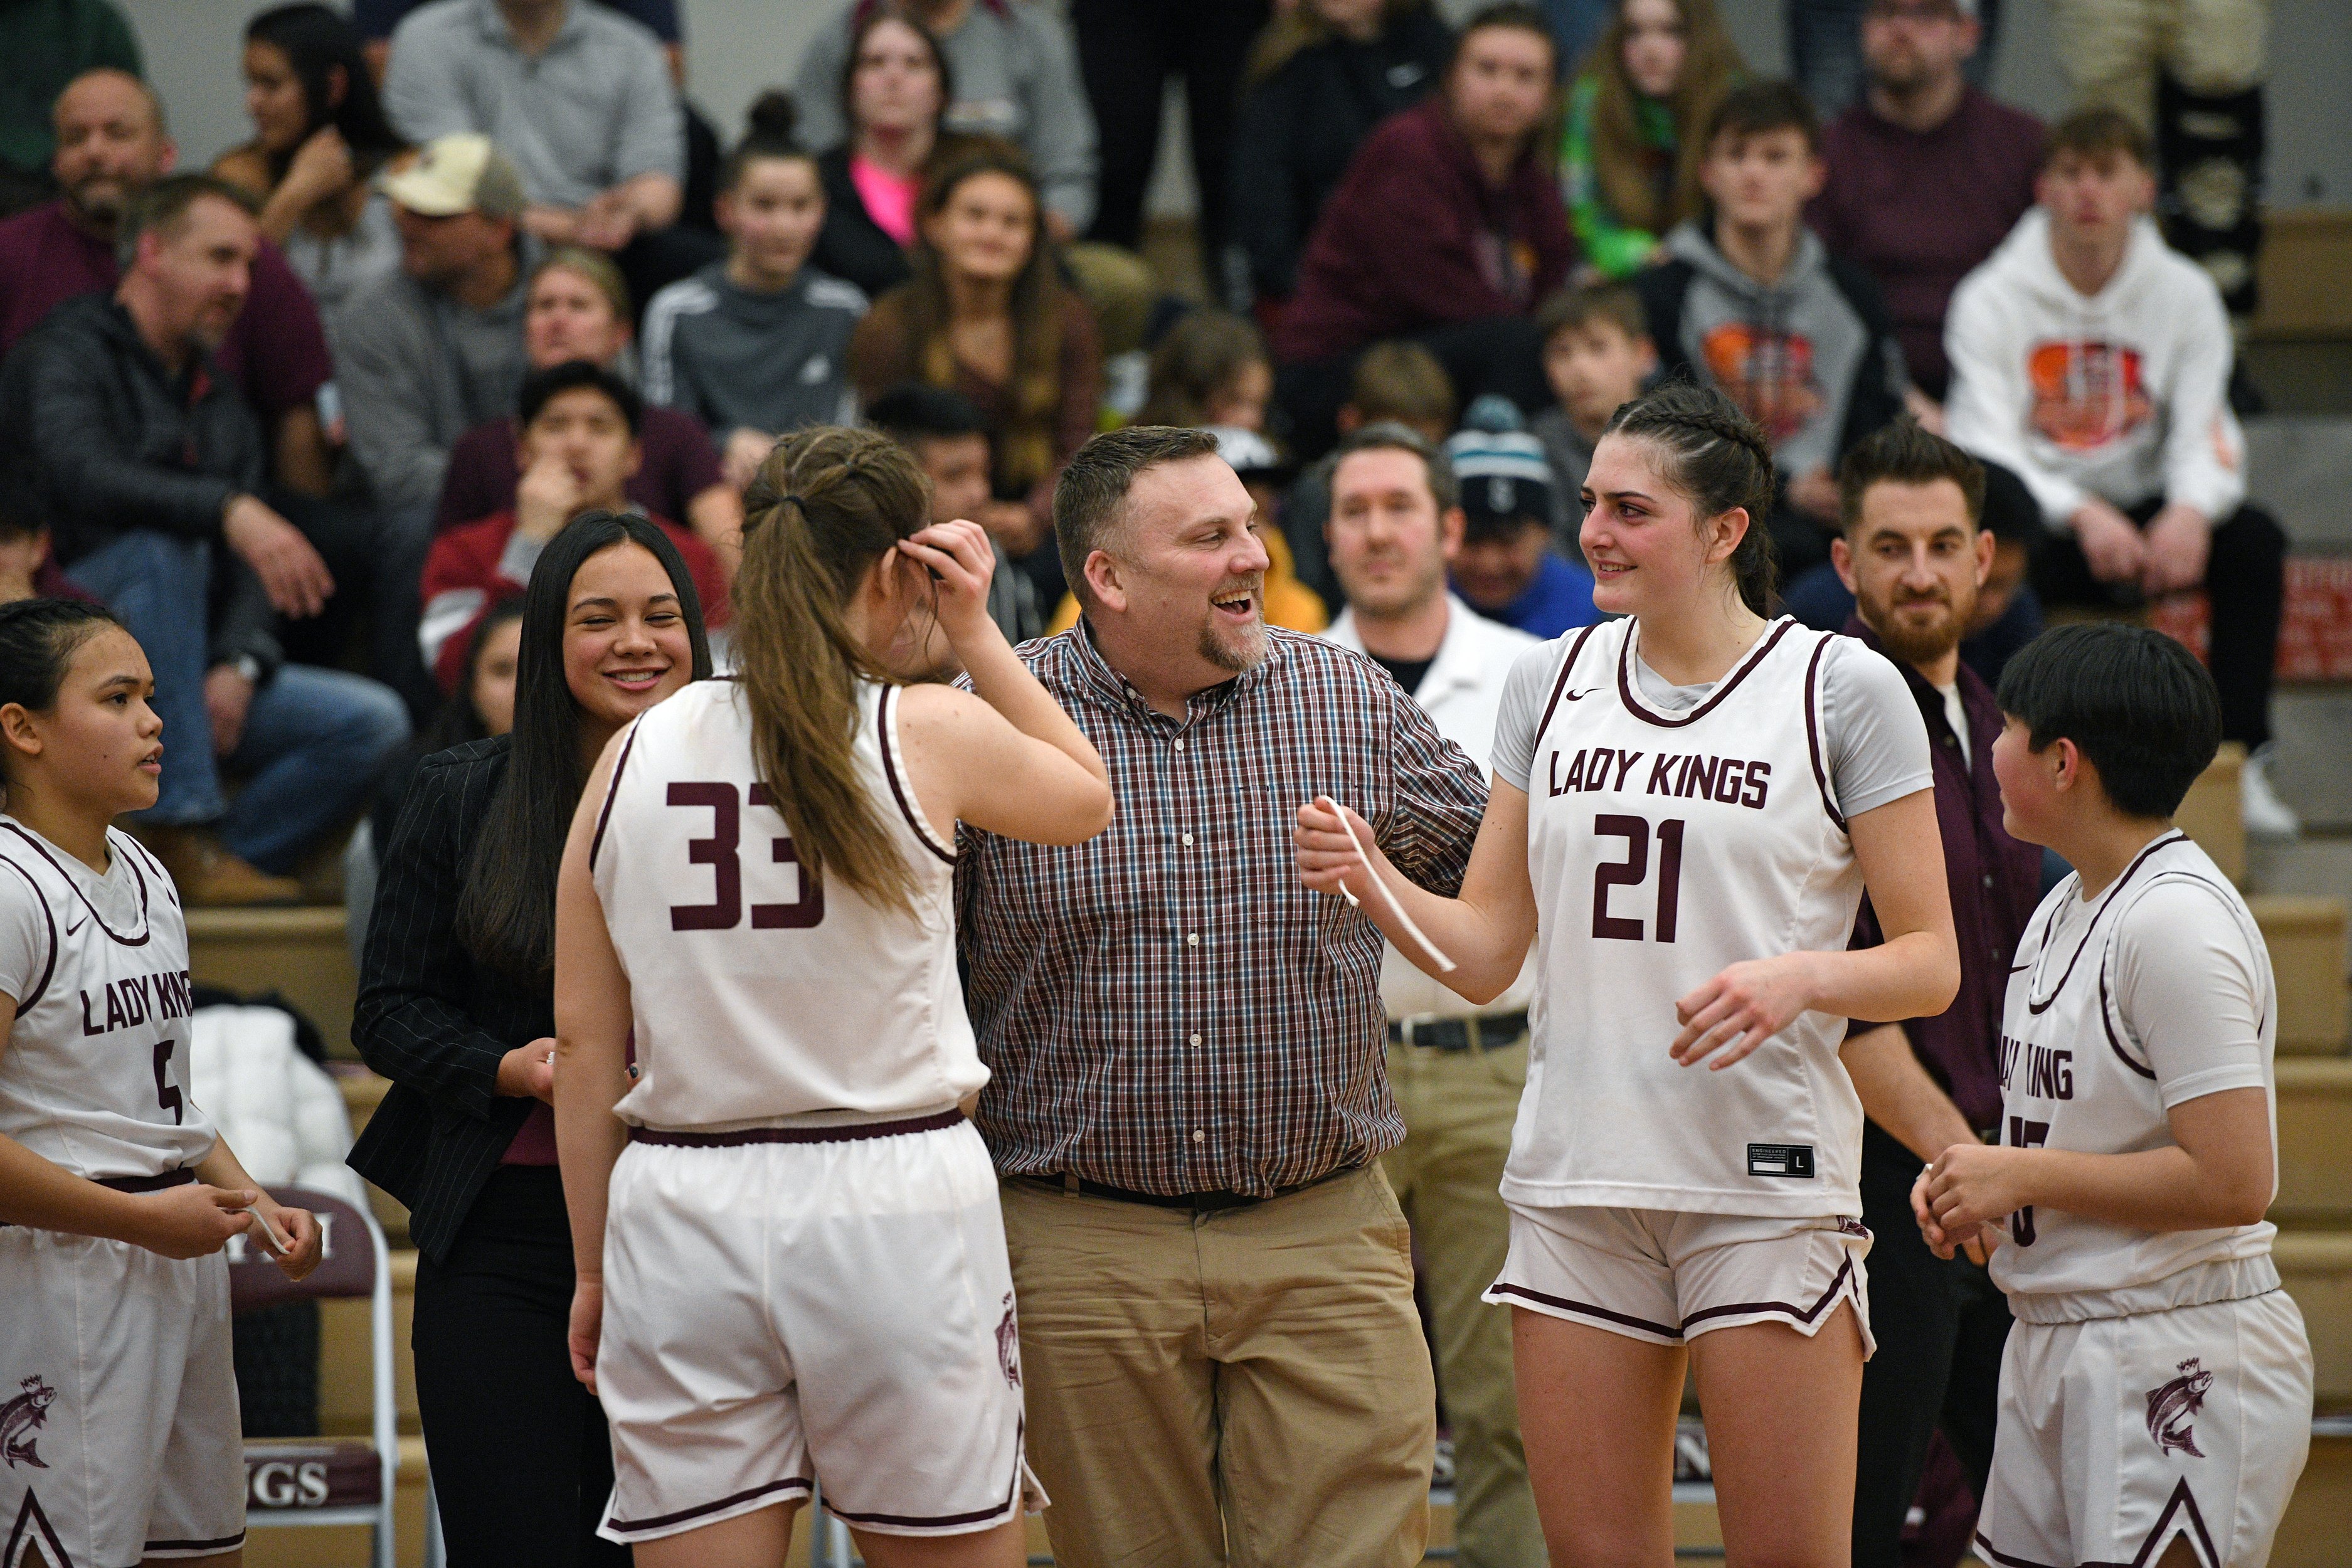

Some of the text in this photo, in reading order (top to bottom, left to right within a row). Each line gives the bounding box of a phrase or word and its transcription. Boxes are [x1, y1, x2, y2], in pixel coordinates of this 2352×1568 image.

[1549, 748, 1771, 810] LADY KINGS
[666, 781, 824, 931] 33
[1592, 814, 1685, 943] 21
[80, 975, 152, 1036] LADY
[1796, 1156, 1804, 1168] L
[245, 1462, 329, 1507] GS
